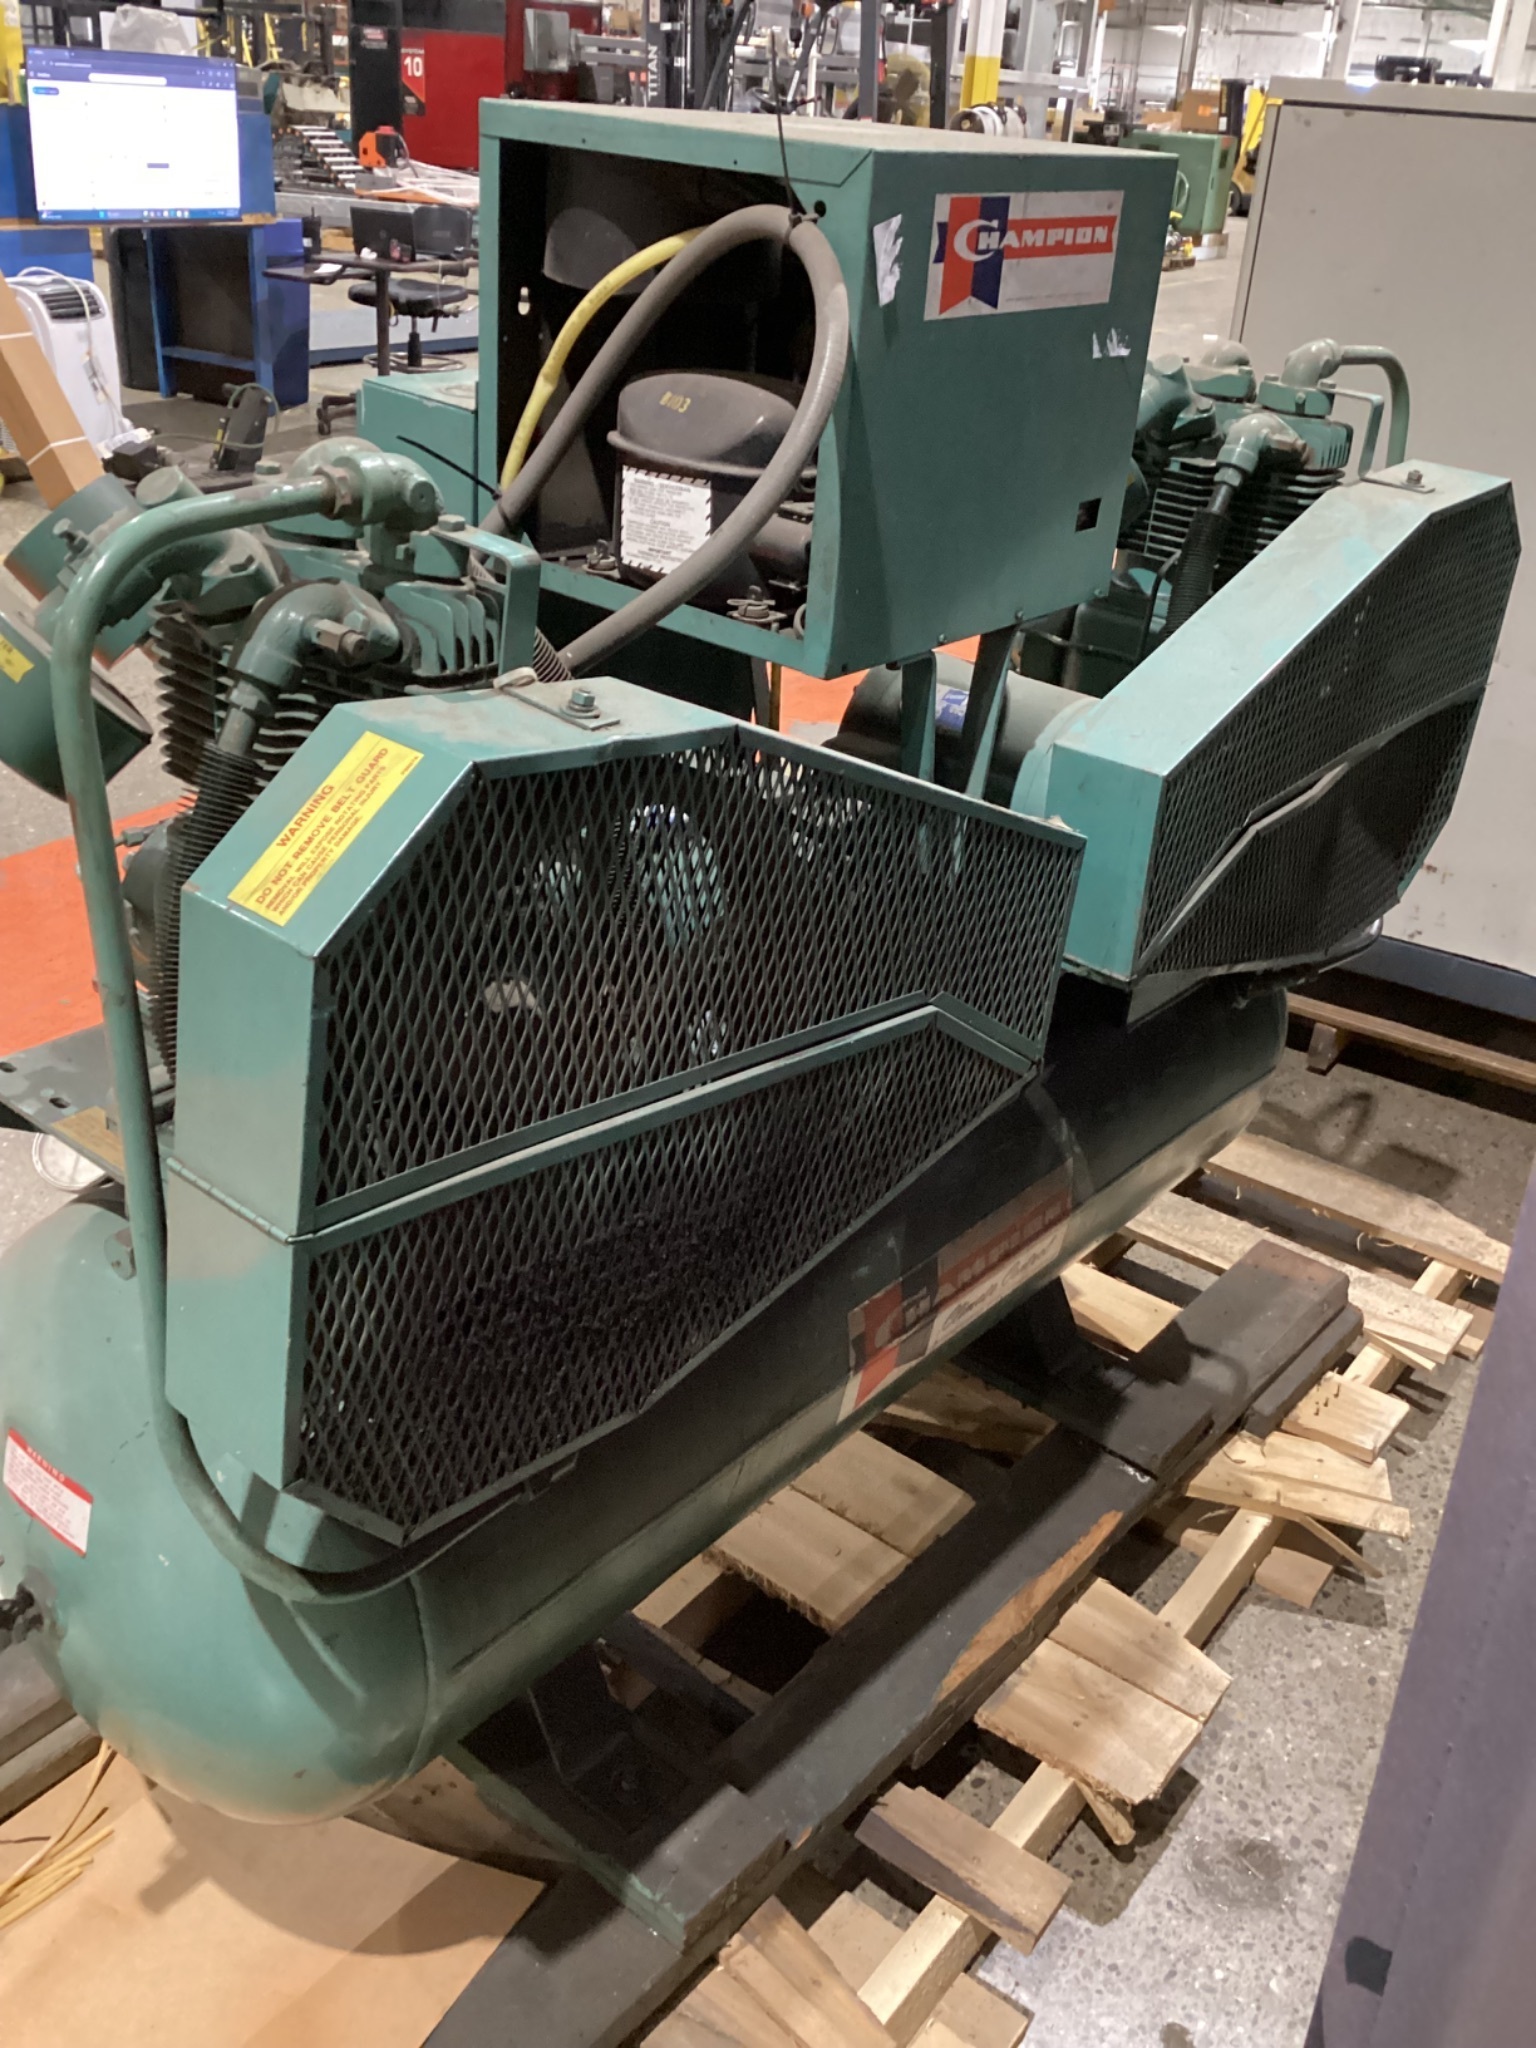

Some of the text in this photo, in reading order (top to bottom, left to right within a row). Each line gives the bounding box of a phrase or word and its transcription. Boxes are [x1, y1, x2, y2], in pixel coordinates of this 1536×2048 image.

[403, 56, 423, 77] 10
[647, 44, 658, 101] TITAN
[953, 219, 1108, 262] CHAMPION
[255, 749, 388, 904] DO NOT REMOVE BELT GUARD
[265, 767, 384, 908] REMOVAL WILL EXPOSE ROTATING PARTS
[271, 783, 379, 911] WHICH CAN CAUSE PERSONAL INJURY
[275, 785, 333, 848] WARNING
[277, 888, 302, 915] AND/OR
[301, 849, 334, 886] PROPERTY
